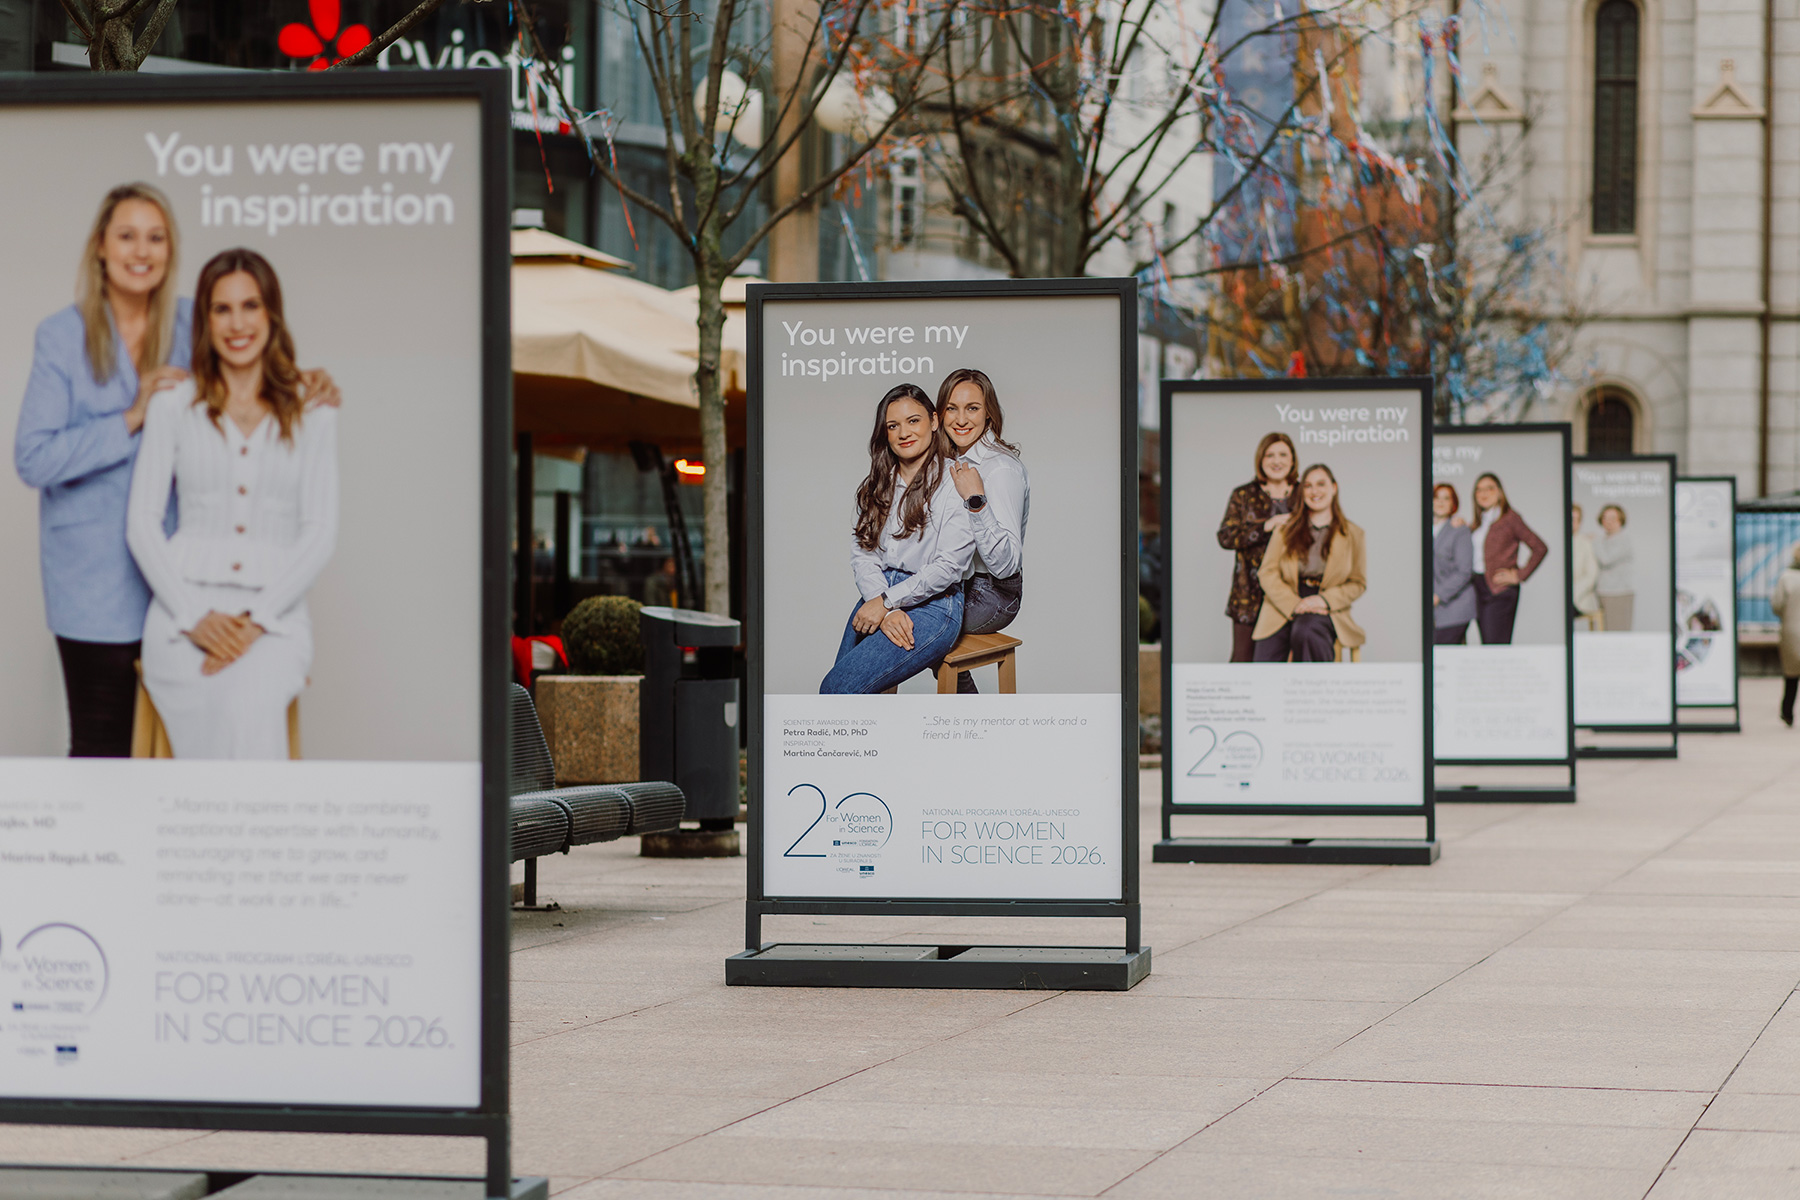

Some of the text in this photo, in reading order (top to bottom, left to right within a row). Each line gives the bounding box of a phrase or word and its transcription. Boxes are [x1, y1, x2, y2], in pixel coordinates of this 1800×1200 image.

[145, 131, 454, 184] You were my
[200, 182, 455, 236] inspiration
[781, 320, 969, 349] You were my
[781, 350, 934, 382] inspiration
[1275, 403, 1408, 424] You were my
[1299, 424, 1409, 447] inspiration
[953, 717, 961, 726] is
[963, 718, 979, 728] my
[980, 717, 1017, 726] mentor
[1018, 717, 1030, 726] at
[1032, 716, 1056, 726] work
[1058, 716, 1079, 726] and
[1080, 718, 1088, 726] a
[783, 728, 869, 737] Petra Radić, MD, PhD
[922, 730, 950, 740] friend
[952, 730, 962, 740] in
[783, 749, 816, 757] Martina
[863, 749, 879, 757] MD
[1282, 750, 1385, 766] FOR WOMEN
[1282, 766, 1299, 782] IN
[1303, 766, 1368, 783] SCIENCE
[826, 812, 882, 823] For Women
[922, 808, 964, 816] NATIONAL
[965, 808, 1008, 816] PROGRAM
[838, 822, 885, 834] in Science
[921, 821, 1065, 841] FOR WOMEN
[921, 845, 1106, 865] IN SCIENCE 2026.
[154, 971, 391, 1008] FOR WOMEN
[154, 1011, 456, 1050] IN SCIENCE 2026.
